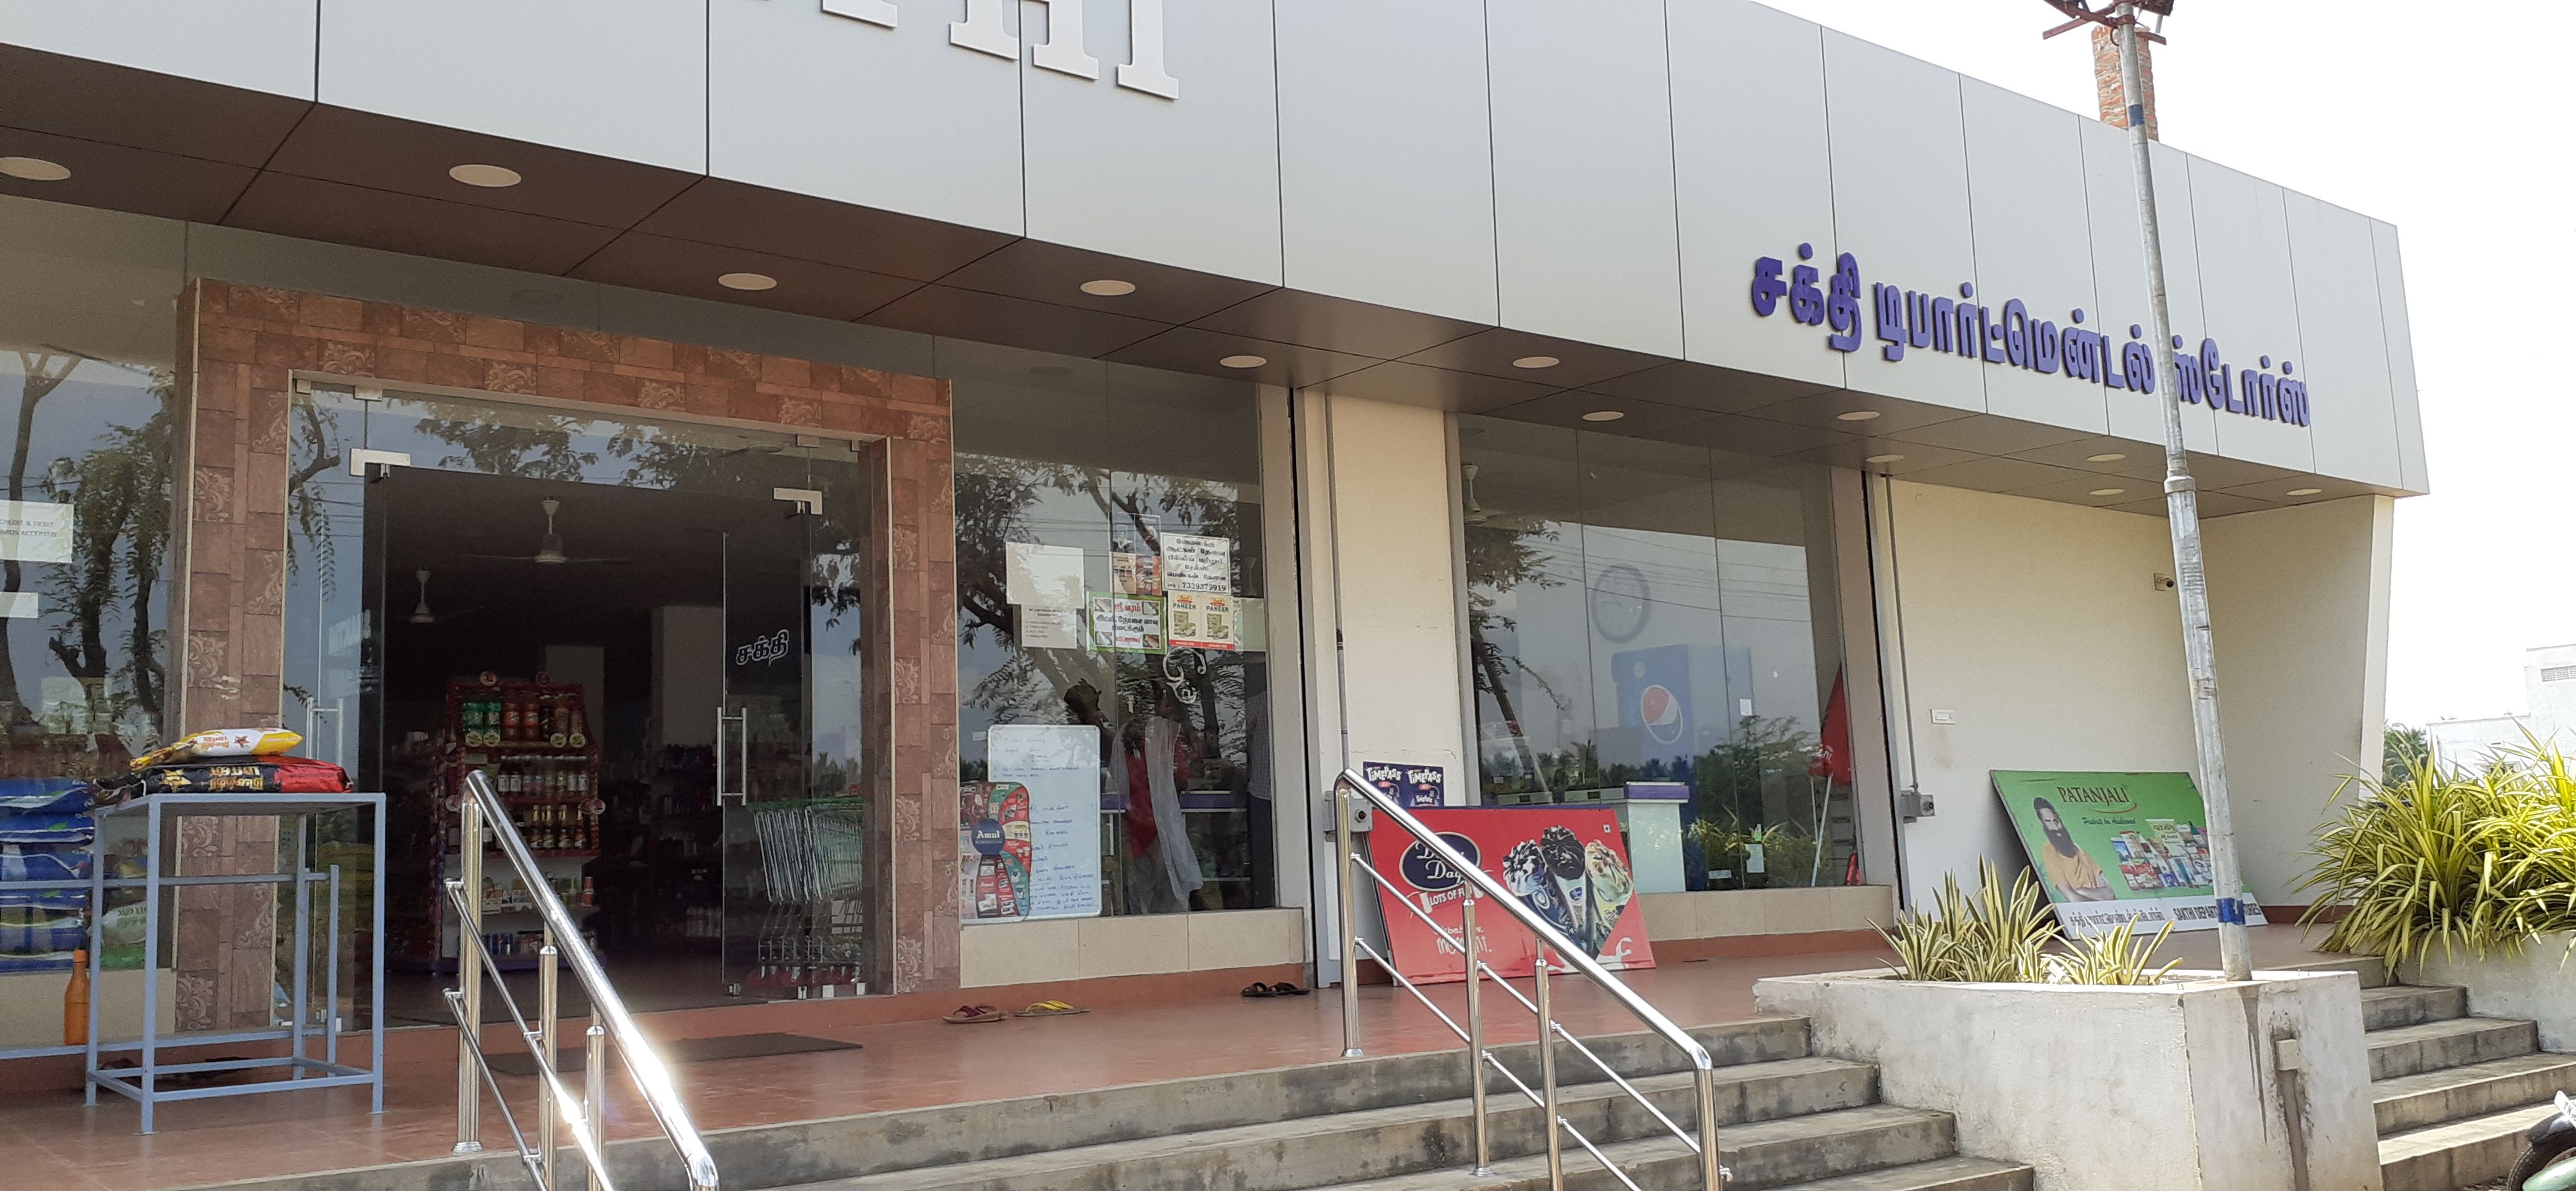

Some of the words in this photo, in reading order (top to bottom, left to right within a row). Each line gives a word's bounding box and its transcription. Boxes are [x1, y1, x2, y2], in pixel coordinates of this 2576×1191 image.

[1752, 242, 1862, 352] சக்தி
[1182, 582, 1227, 591] 7339379919
[736, 629, 789, 667] சக்தி
[2056, 787, 2130, 807] PATANJALI
[977, 830, 1000, 840] Amul
[1429, 894, 1447, 906] LOTS
[1447, 891, 1458, 901] OF
[2172, 907, 2197, 921] SAKTHI
